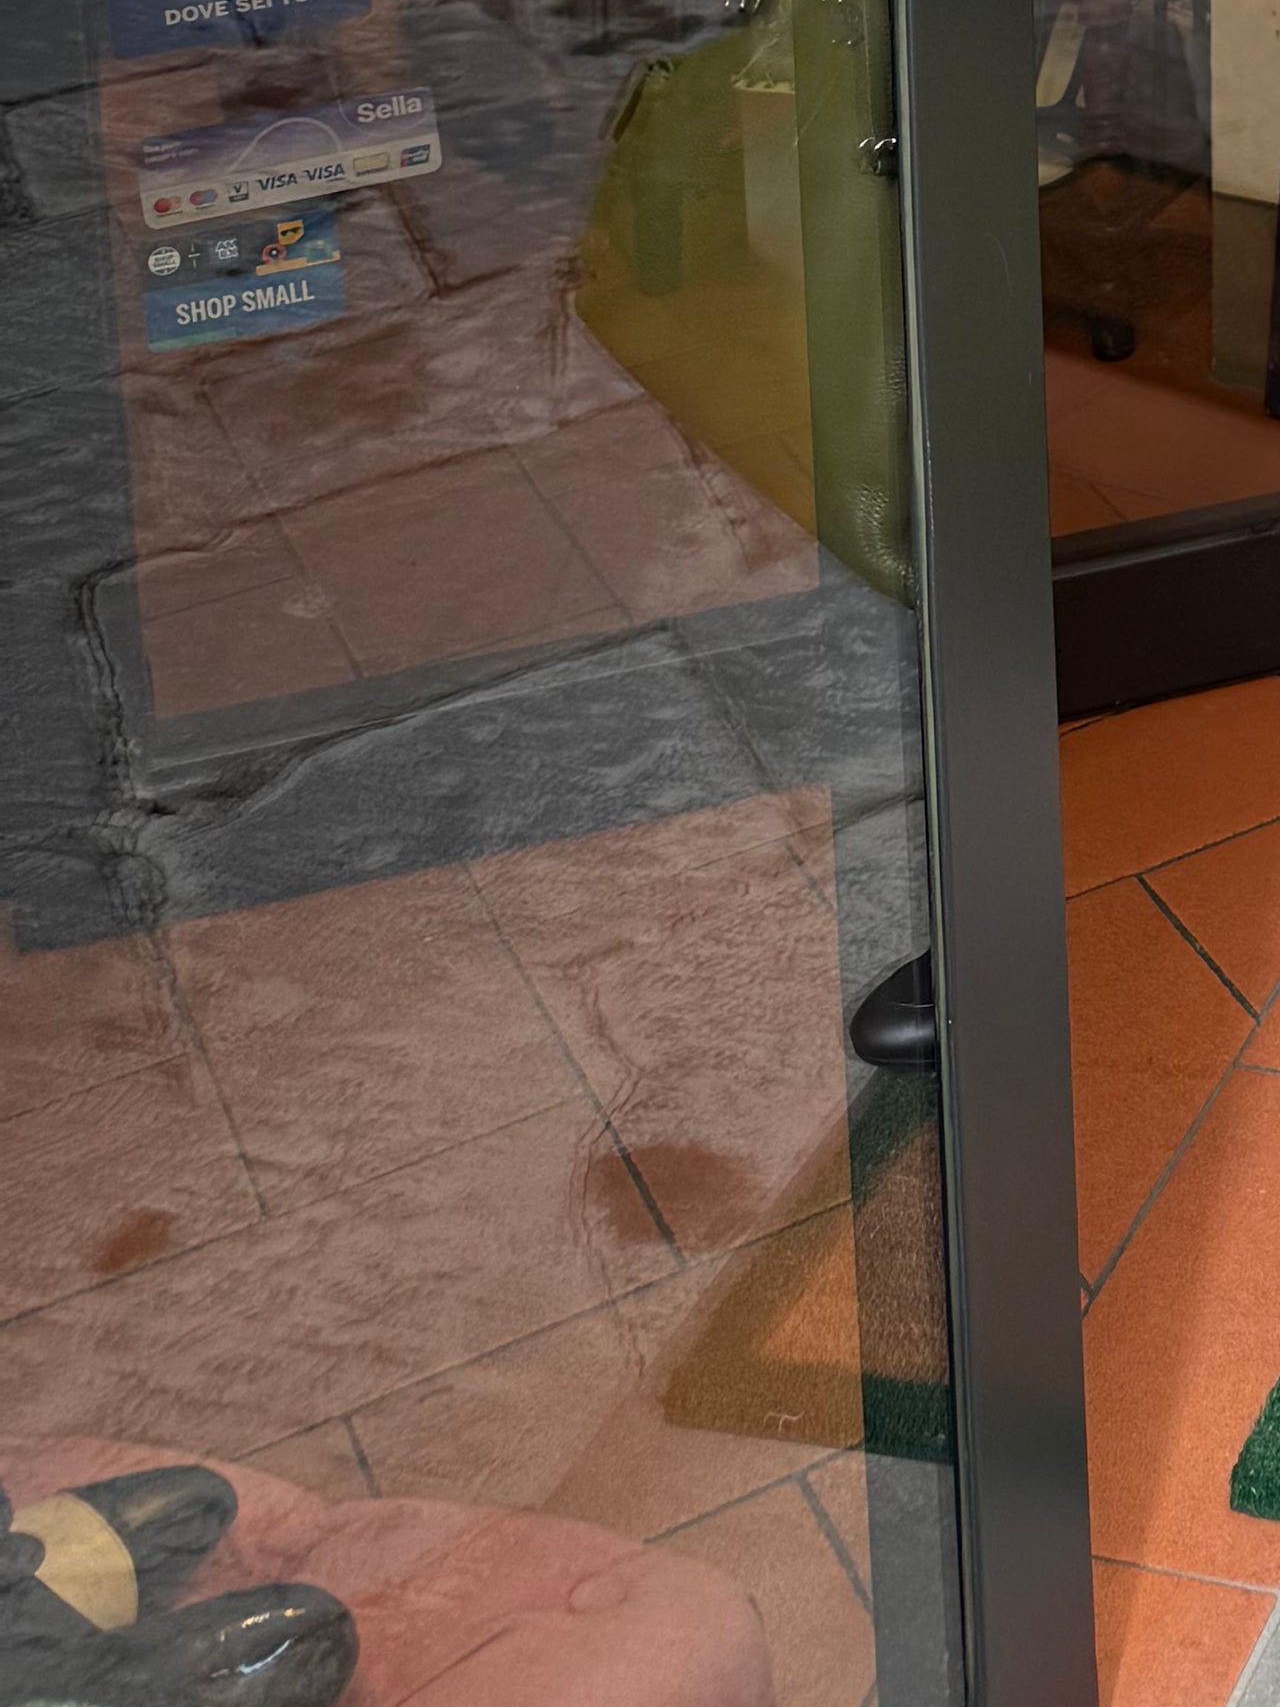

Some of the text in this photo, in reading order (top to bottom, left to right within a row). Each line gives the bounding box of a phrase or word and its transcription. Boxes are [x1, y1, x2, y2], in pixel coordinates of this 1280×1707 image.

[165, 0, 229, 26] DOVE
[357, 96, 422, 123] Sella
[257, 173, 297, 191] VISA
[304, 163, 346, 181] VISA
[176, 280, 315, 325] SHOP SMALL
